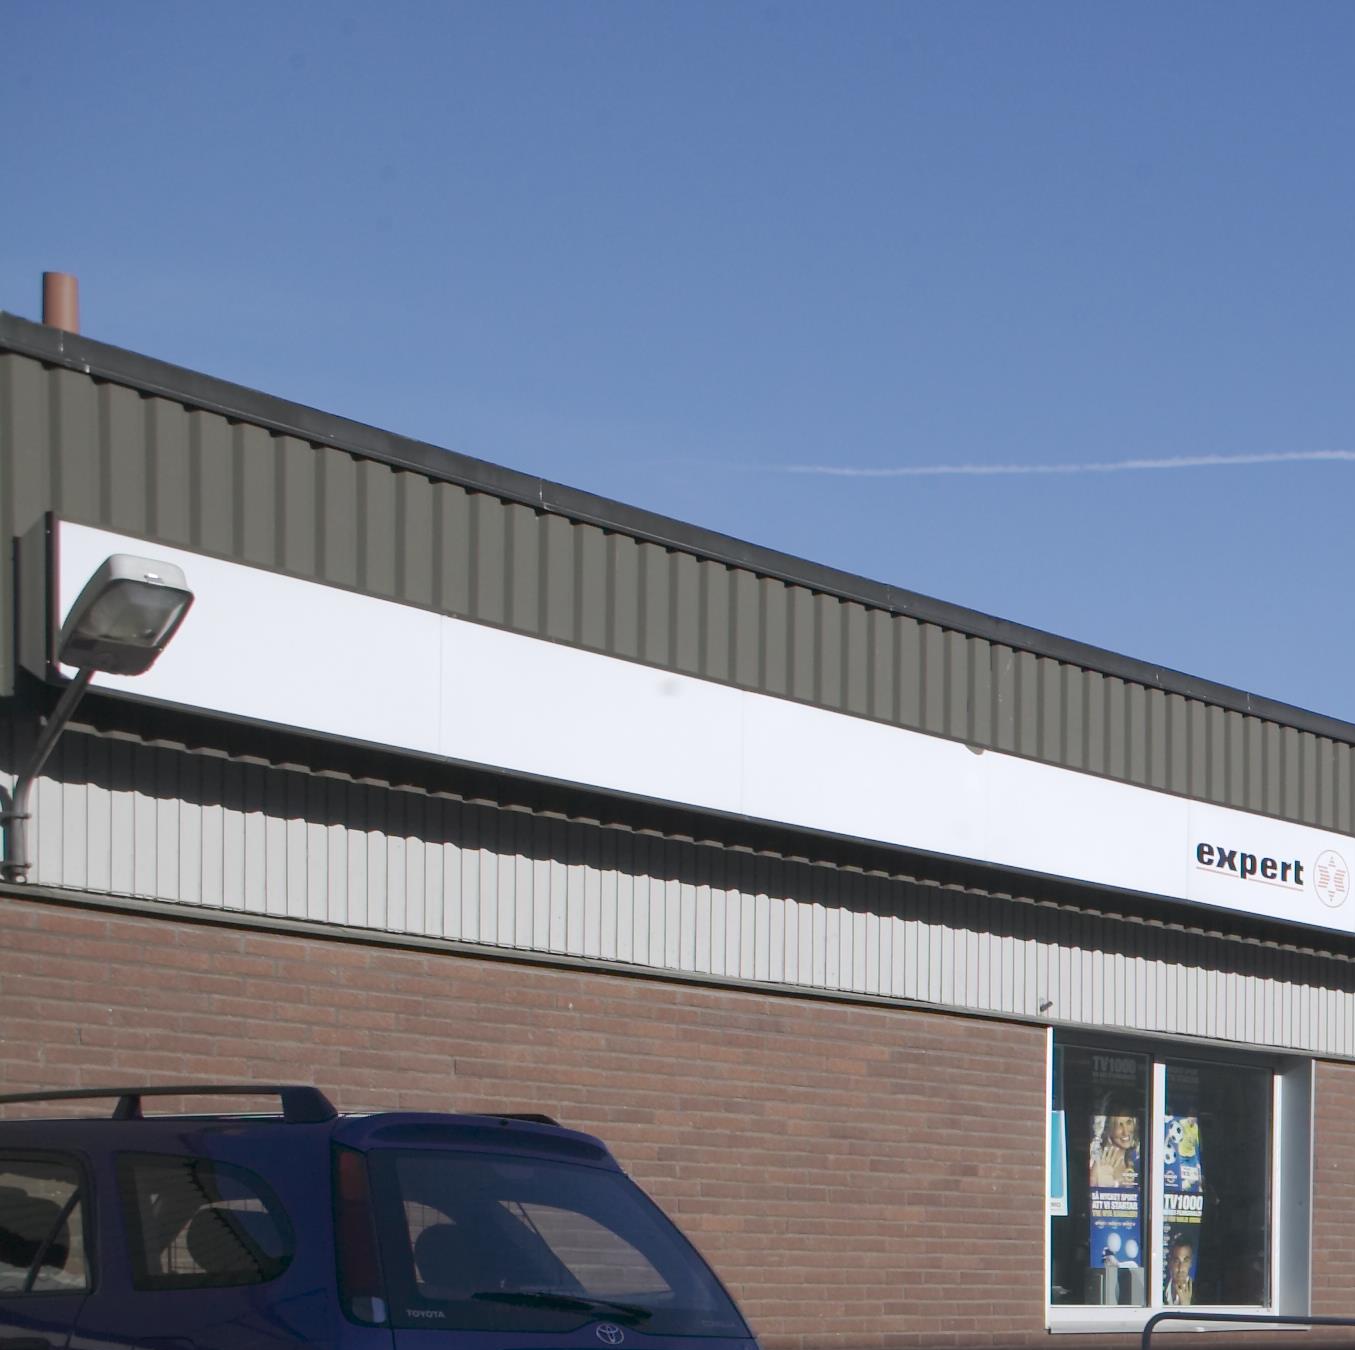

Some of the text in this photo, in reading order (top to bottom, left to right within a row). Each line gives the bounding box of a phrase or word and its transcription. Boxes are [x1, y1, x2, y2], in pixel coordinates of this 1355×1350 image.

[1196, 842, 1304, 886] expert
[1164, 1193, 1204, 1210] TV1000
[406, 1309, 446, 1319] TOYOTA
